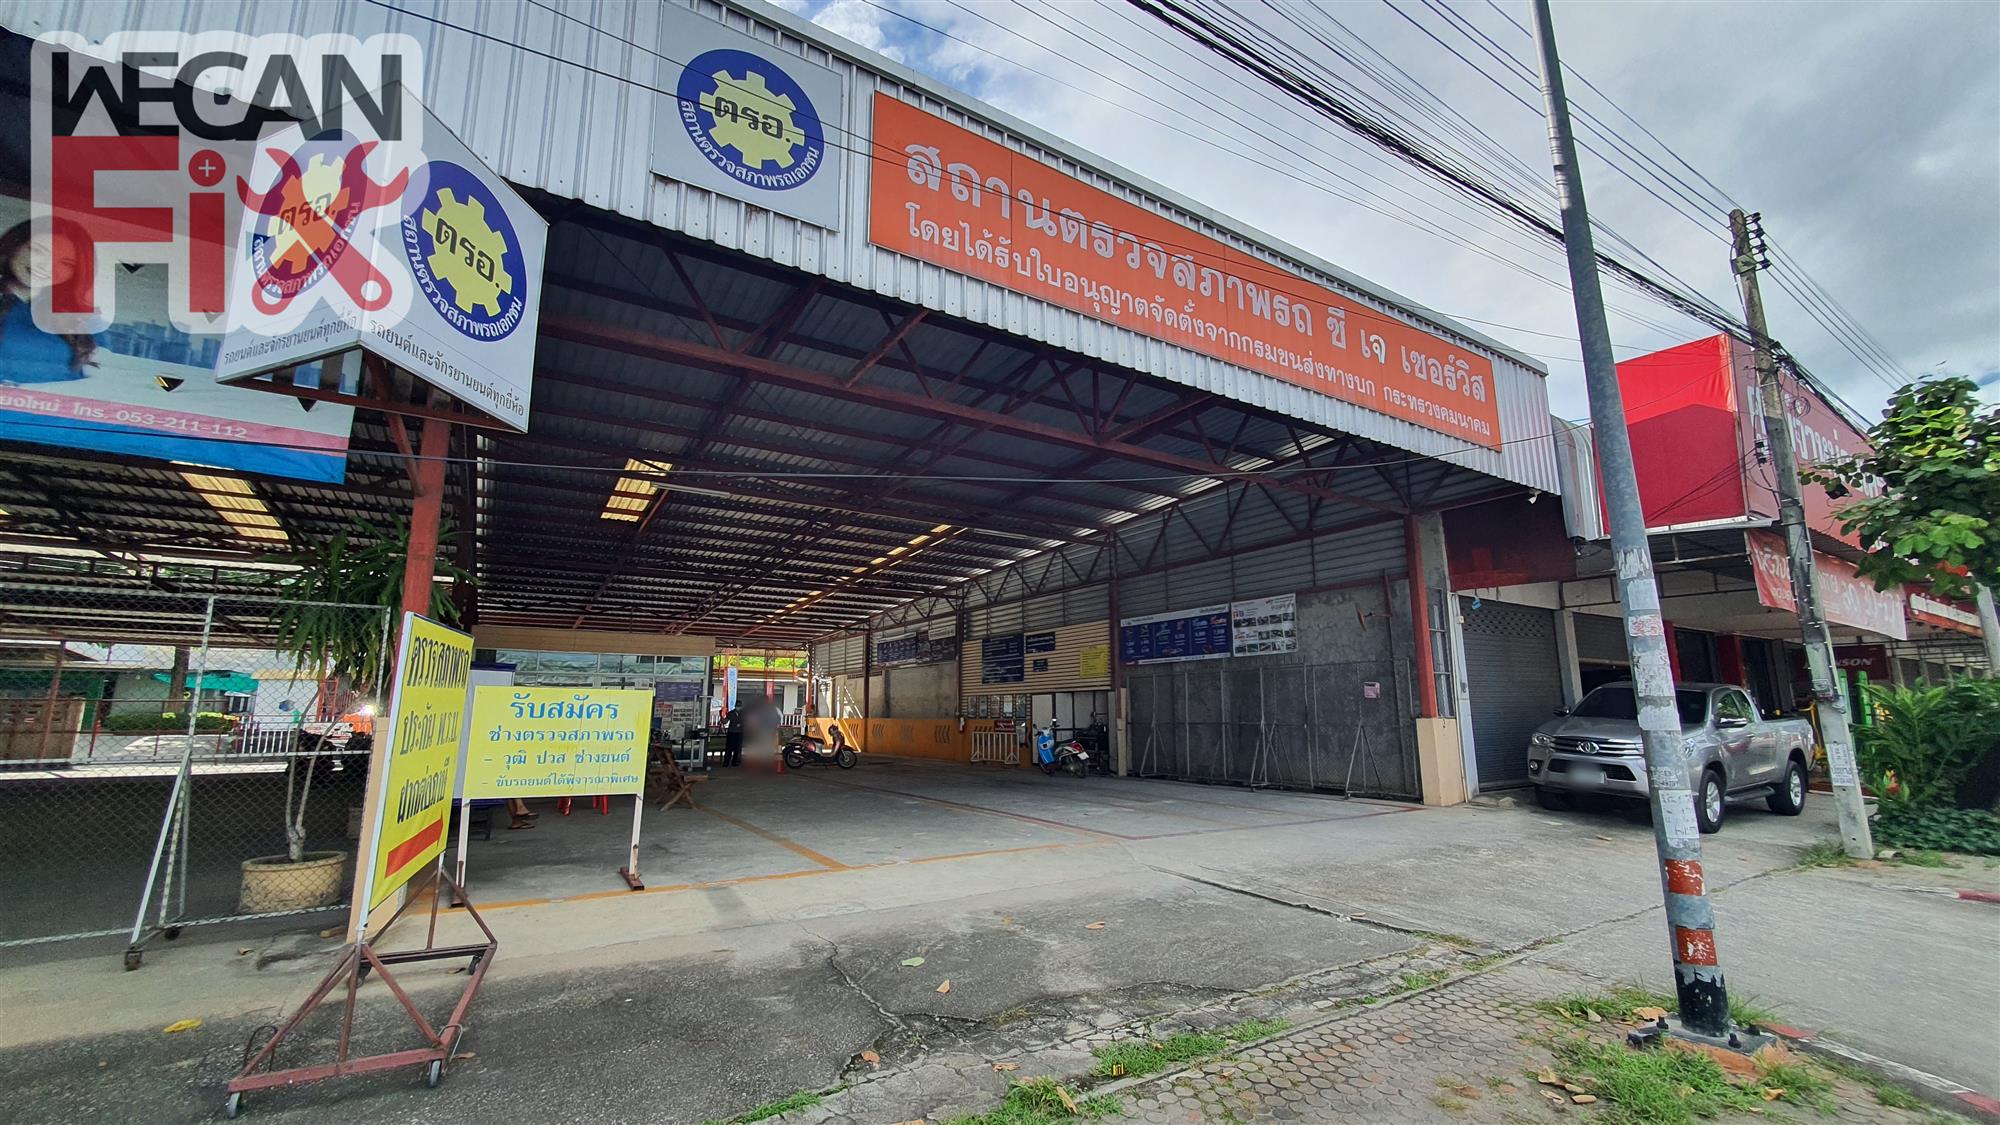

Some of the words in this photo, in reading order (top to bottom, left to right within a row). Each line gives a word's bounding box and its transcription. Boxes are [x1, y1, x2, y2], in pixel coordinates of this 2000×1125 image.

[680, 100, 820, 187] สถานตรวจสภาพรถเอกชน
[714, 96, 791, 143] ตรอ.
[402, 213, 523, 338] สถานตรวจสภาพรถเอกชน
[434, 217, 501, 289] ตรอ.
[905, 143, 1313, 337] สถานตรวจสภาพรถ
[1360, 329, 1387, 364] เจ
[904, 201, 1376, 398] โดยได้รับใบอนุญาตจัดตั้งจากกรมขนส่งทางบก
[1383, 385, 1490, 437] กระทรวงคมนาคม
[368, 318, 525, 417] รถยนต์และจักรยานยนต์ทุกยี่ห้อ
[116, 409, 248, 439] 053-211-112
[406, 636, 470, 689] ตรวจสภาพรถ
[400, 702, 436, 756] ประกัน
[488, 724, 635, 742] ช่างตรวจสภาพรถ
[510, 692, 620, 720] รับสมัคร
[503, 750, 527, 771] วุฒิ
[536, 750, 566, 765] ปวส
[575, 748, 632, 765] ช่างยนต์
